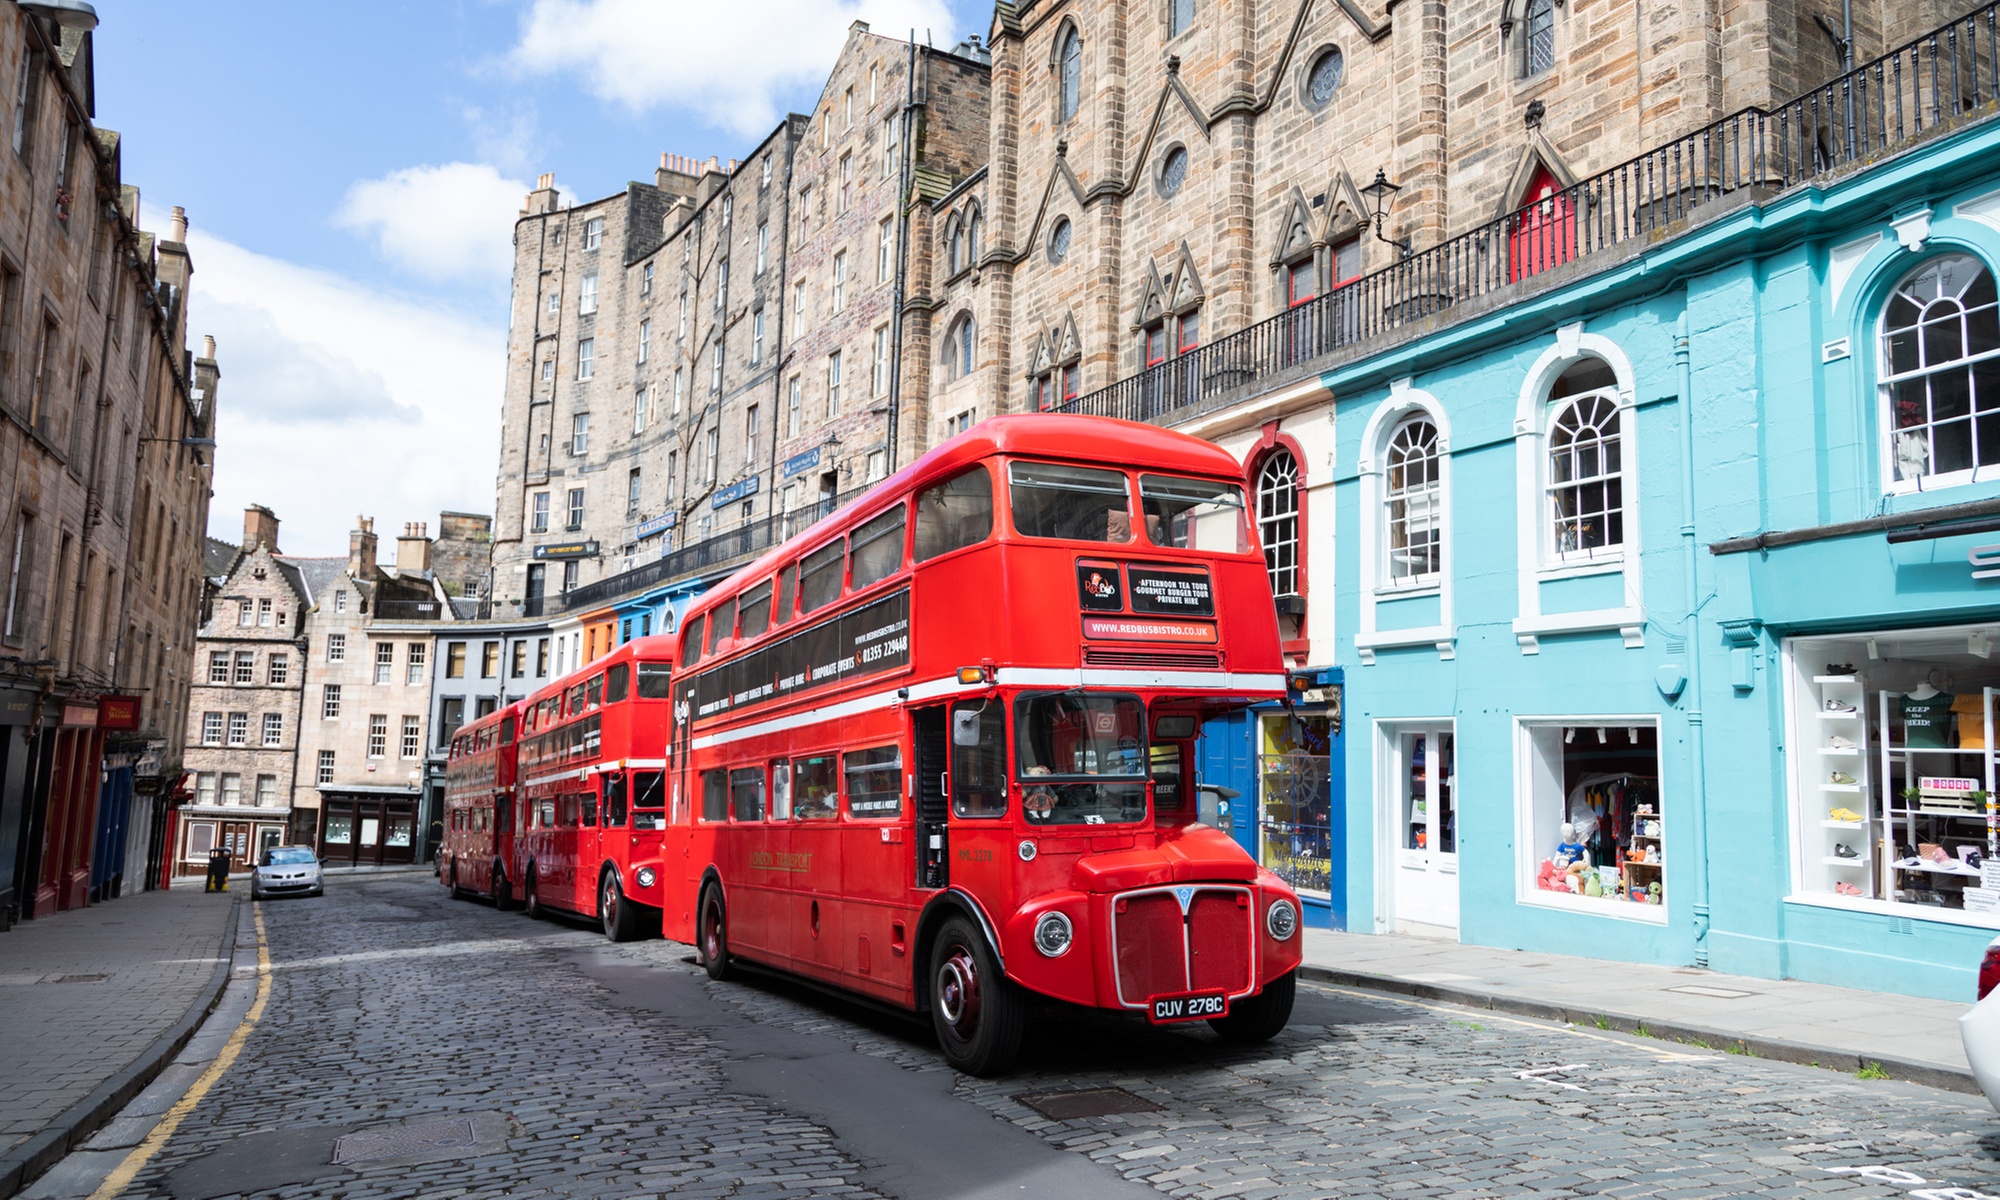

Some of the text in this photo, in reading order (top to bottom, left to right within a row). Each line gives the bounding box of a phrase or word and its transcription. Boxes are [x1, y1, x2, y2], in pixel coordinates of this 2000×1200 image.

[1141, 579, 1208, 591] AFTERNOON TEA TOUR
[1136, 587, 1209, 598] GOURMET BURGER TOUR
[1157, 595, 1199, 605] PRIVATE HIRE
[1091, 623, 1208, 636] WWW.REDBUSBISTRO.CO.UK
[812, 662, 836, 680] CORPORATE
[837, 656, 854, 673] EVENTS
[863, 643, 881, 663] 01355
[1906, 719, 1930, 727] HEID!
[1272, 848, 1325, 867] Merchants
[1156, 996, 1223, 1018] CUV 278C
